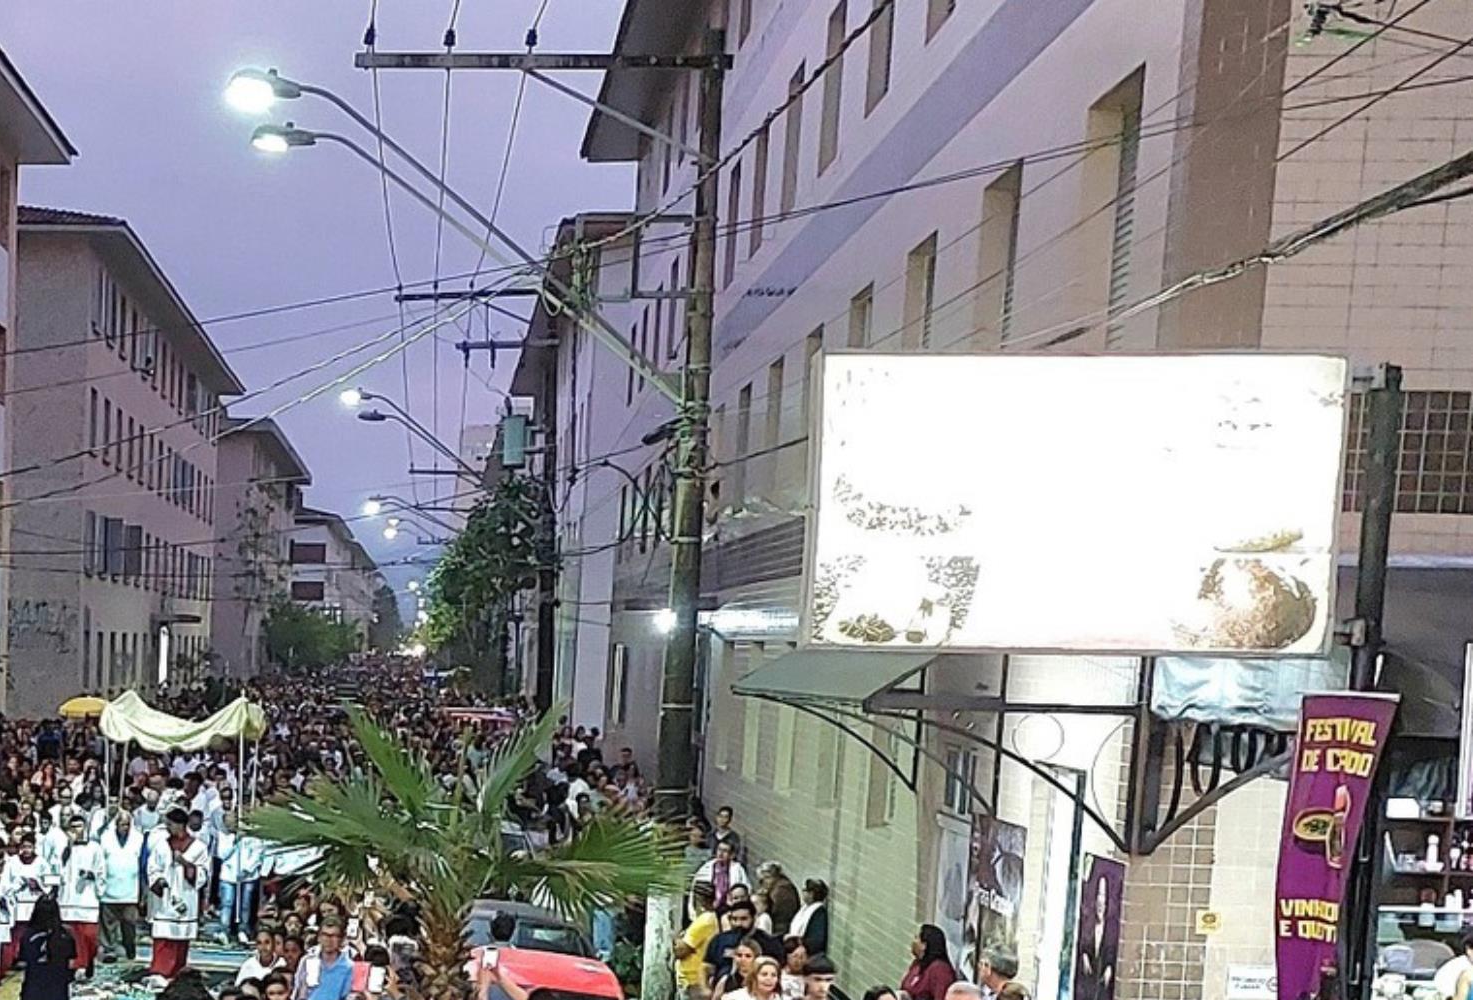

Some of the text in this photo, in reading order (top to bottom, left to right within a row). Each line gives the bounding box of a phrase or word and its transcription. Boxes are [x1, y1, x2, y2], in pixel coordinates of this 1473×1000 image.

[1304, 717, 1377, 746] FESTIVAL
[1300, 749, 1322, 772] DE
[1279, 920, 1293, 937] E
